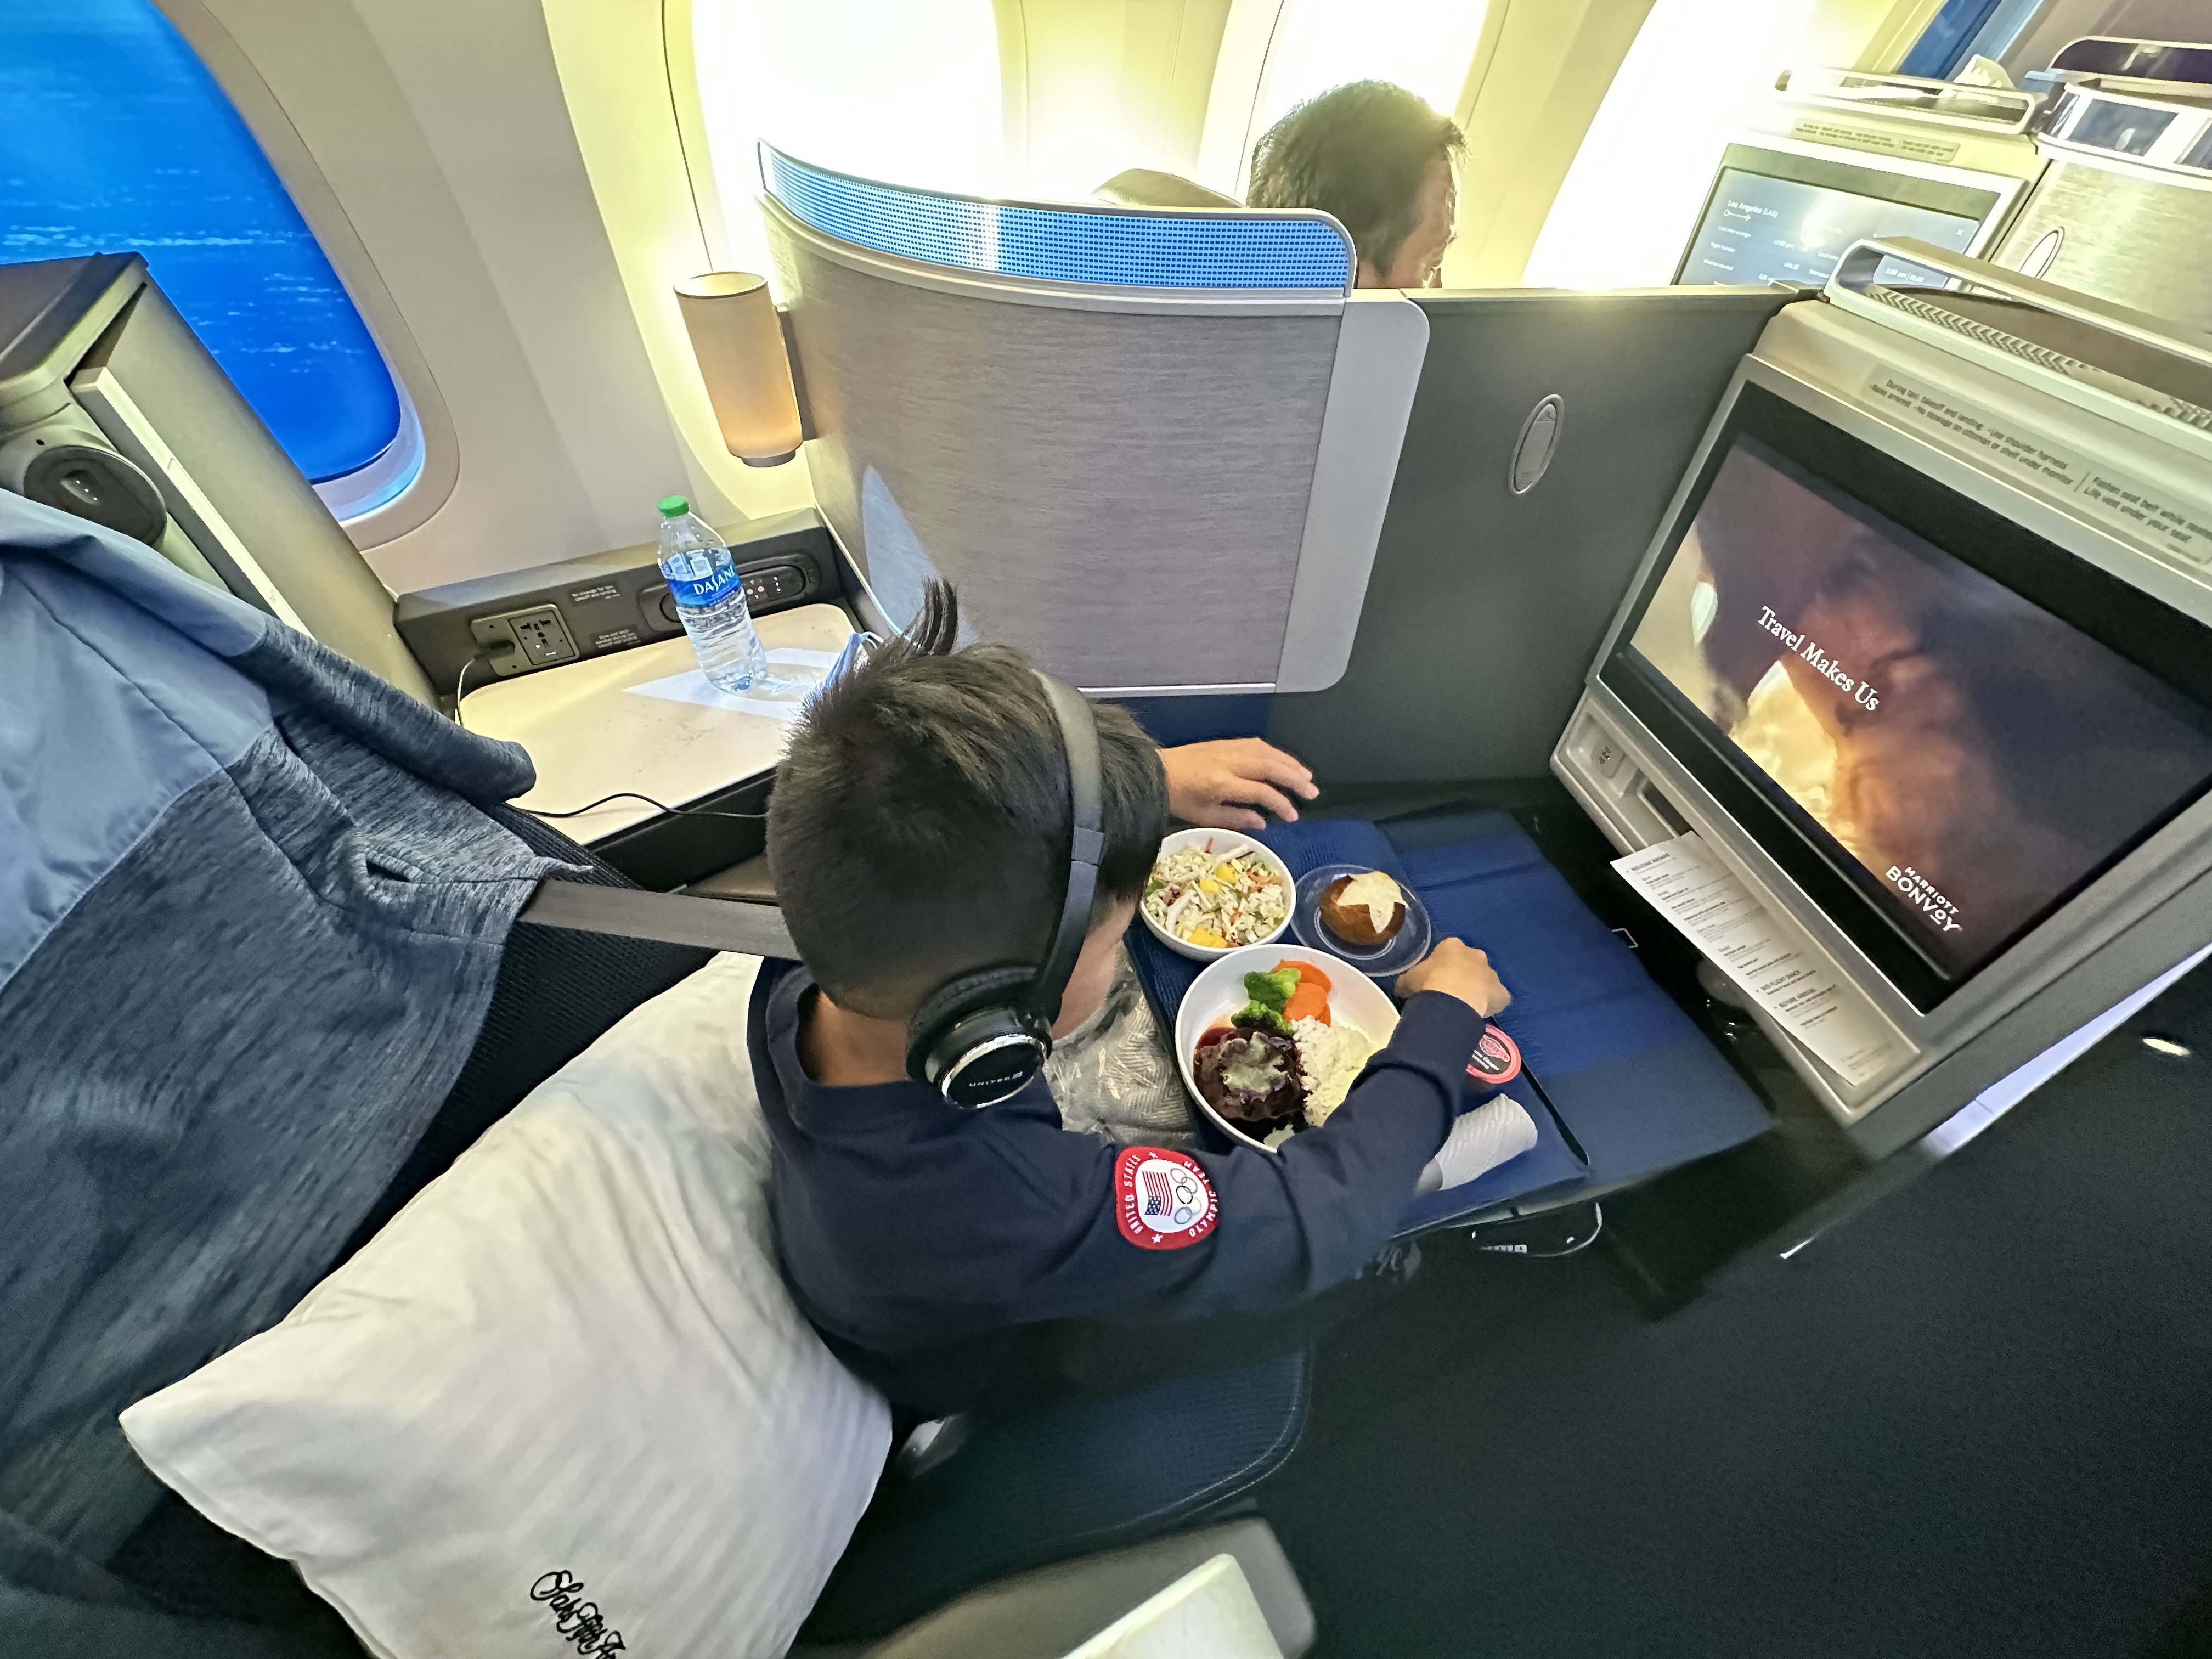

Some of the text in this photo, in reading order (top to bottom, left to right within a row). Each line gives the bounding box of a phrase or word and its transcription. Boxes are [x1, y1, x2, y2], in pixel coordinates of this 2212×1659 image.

[693, 566, 735, 595] DASANI
[1758, 605, 1880, 710] Travel Makes Us
[1885, 865, 1960, 932] BONVOY
[1905, 867, 1959, 915] MARRIOTT
[1123, 1154, 1143, 1234] UNITED STATES
[1184, 1160, 1218, 1237] OLYMPIC TEAM
